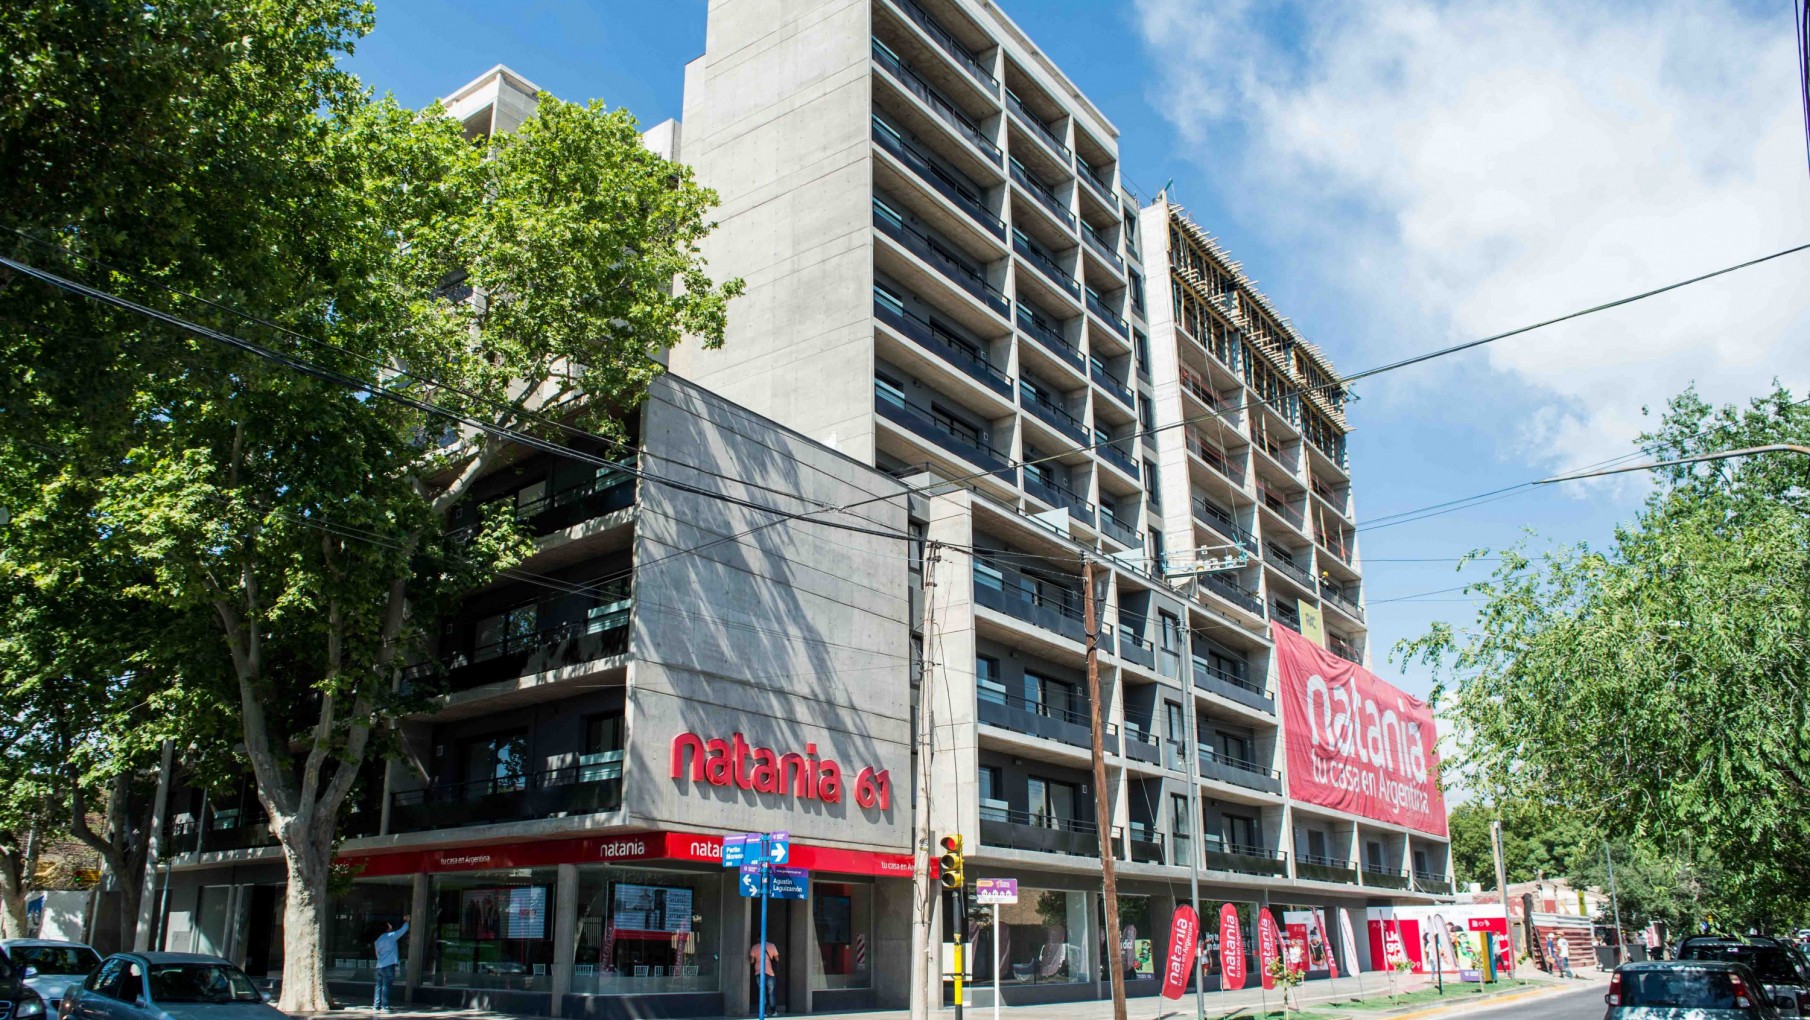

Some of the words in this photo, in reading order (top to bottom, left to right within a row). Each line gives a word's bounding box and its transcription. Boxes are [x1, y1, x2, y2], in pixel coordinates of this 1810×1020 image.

[1307, 674, 1427, 784] natania
[670, 732, 841, 803] natania
[854, 766, 889, 810] 61
[1311, 748, 1326, 784] tu
[1330, 761, 1360, 793] casa
[1362, 770, 1376, 798] en
[1379, 771, 1429, 814] Argentina
[465, 855, 491, 866] Argentina
[600, 838, 645, 857] natania
[881, 861, 888, 869] tu
[888, 862, 900, 870] casa
[1169, 918, 1188, 985] natania
[1224, 915, 1236, 977] natania
